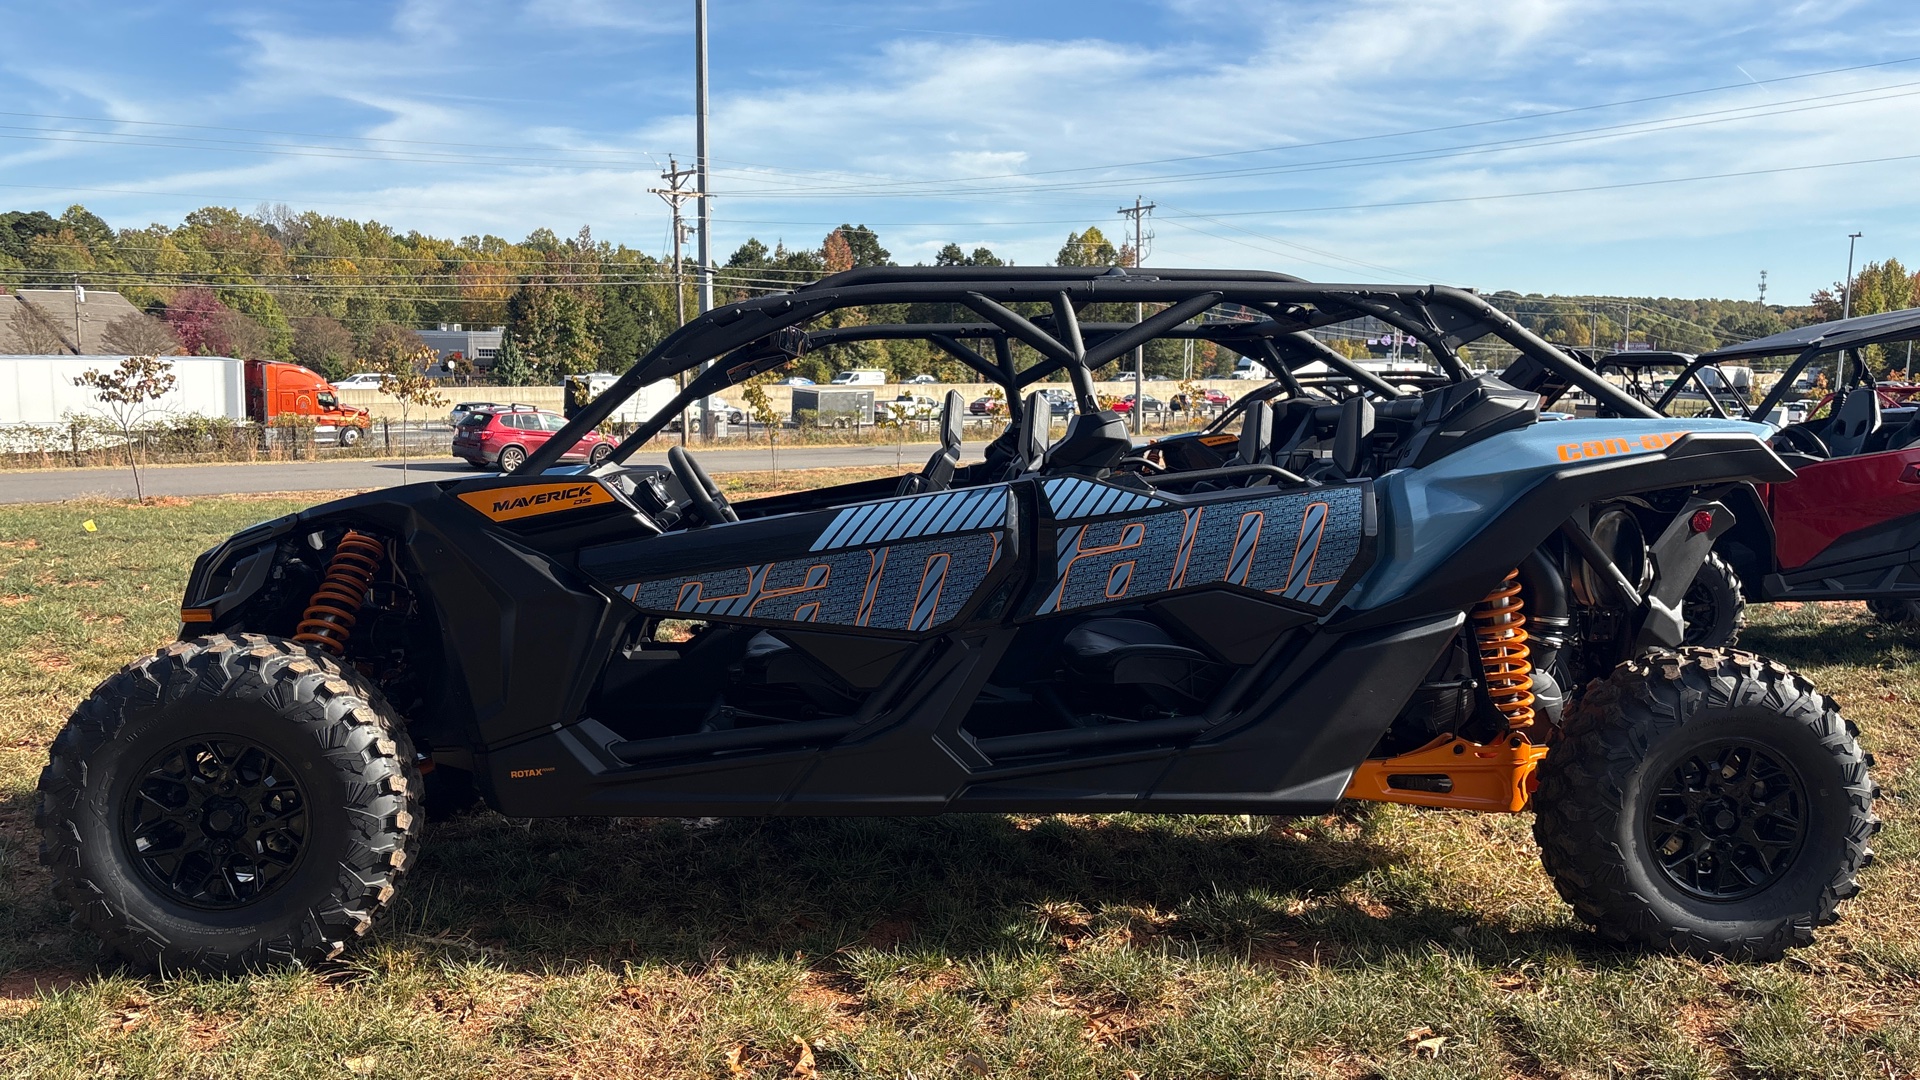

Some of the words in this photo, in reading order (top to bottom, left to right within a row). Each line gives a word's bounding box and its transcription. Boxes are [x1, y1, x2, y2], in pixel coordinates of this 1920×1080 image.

[493, 485, 593, 512] MAVERICK
[573, 497, 592, 505] DS
[511, 768, 542, 778] ROTAX
